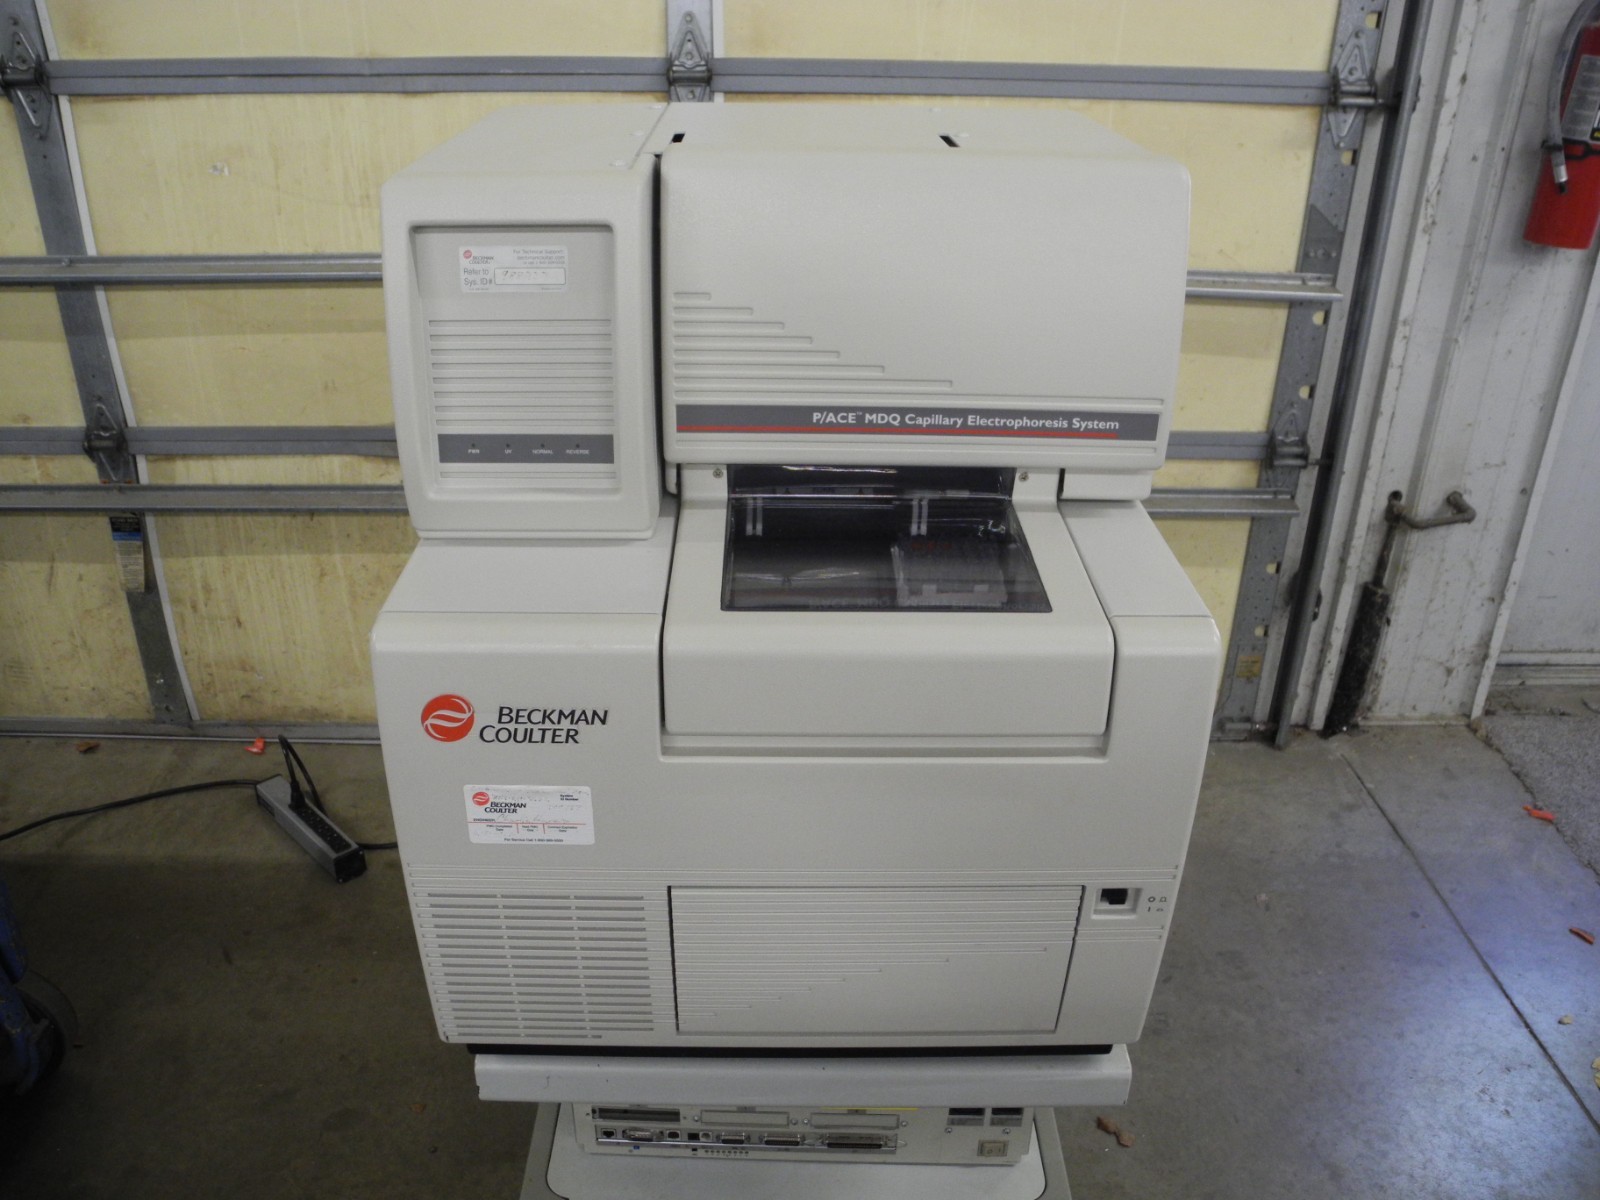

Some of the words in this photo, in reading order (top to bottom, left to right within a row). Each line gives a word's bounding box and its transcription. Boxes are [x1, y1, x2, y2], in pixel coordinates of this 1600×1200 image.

[463, 268, 481, 276] Refer
[482, 268, 490, 276] to
[864, 413, 901, 426] MDQ
[904, 413, 963, 428] Capillary
[967, 415, 1069, 430] Electrophoresis
[1072, 417, 1120, 431] System
[497, 706, 609, 726] BECKMAN
[479, 724, 580, 744] COULTER
